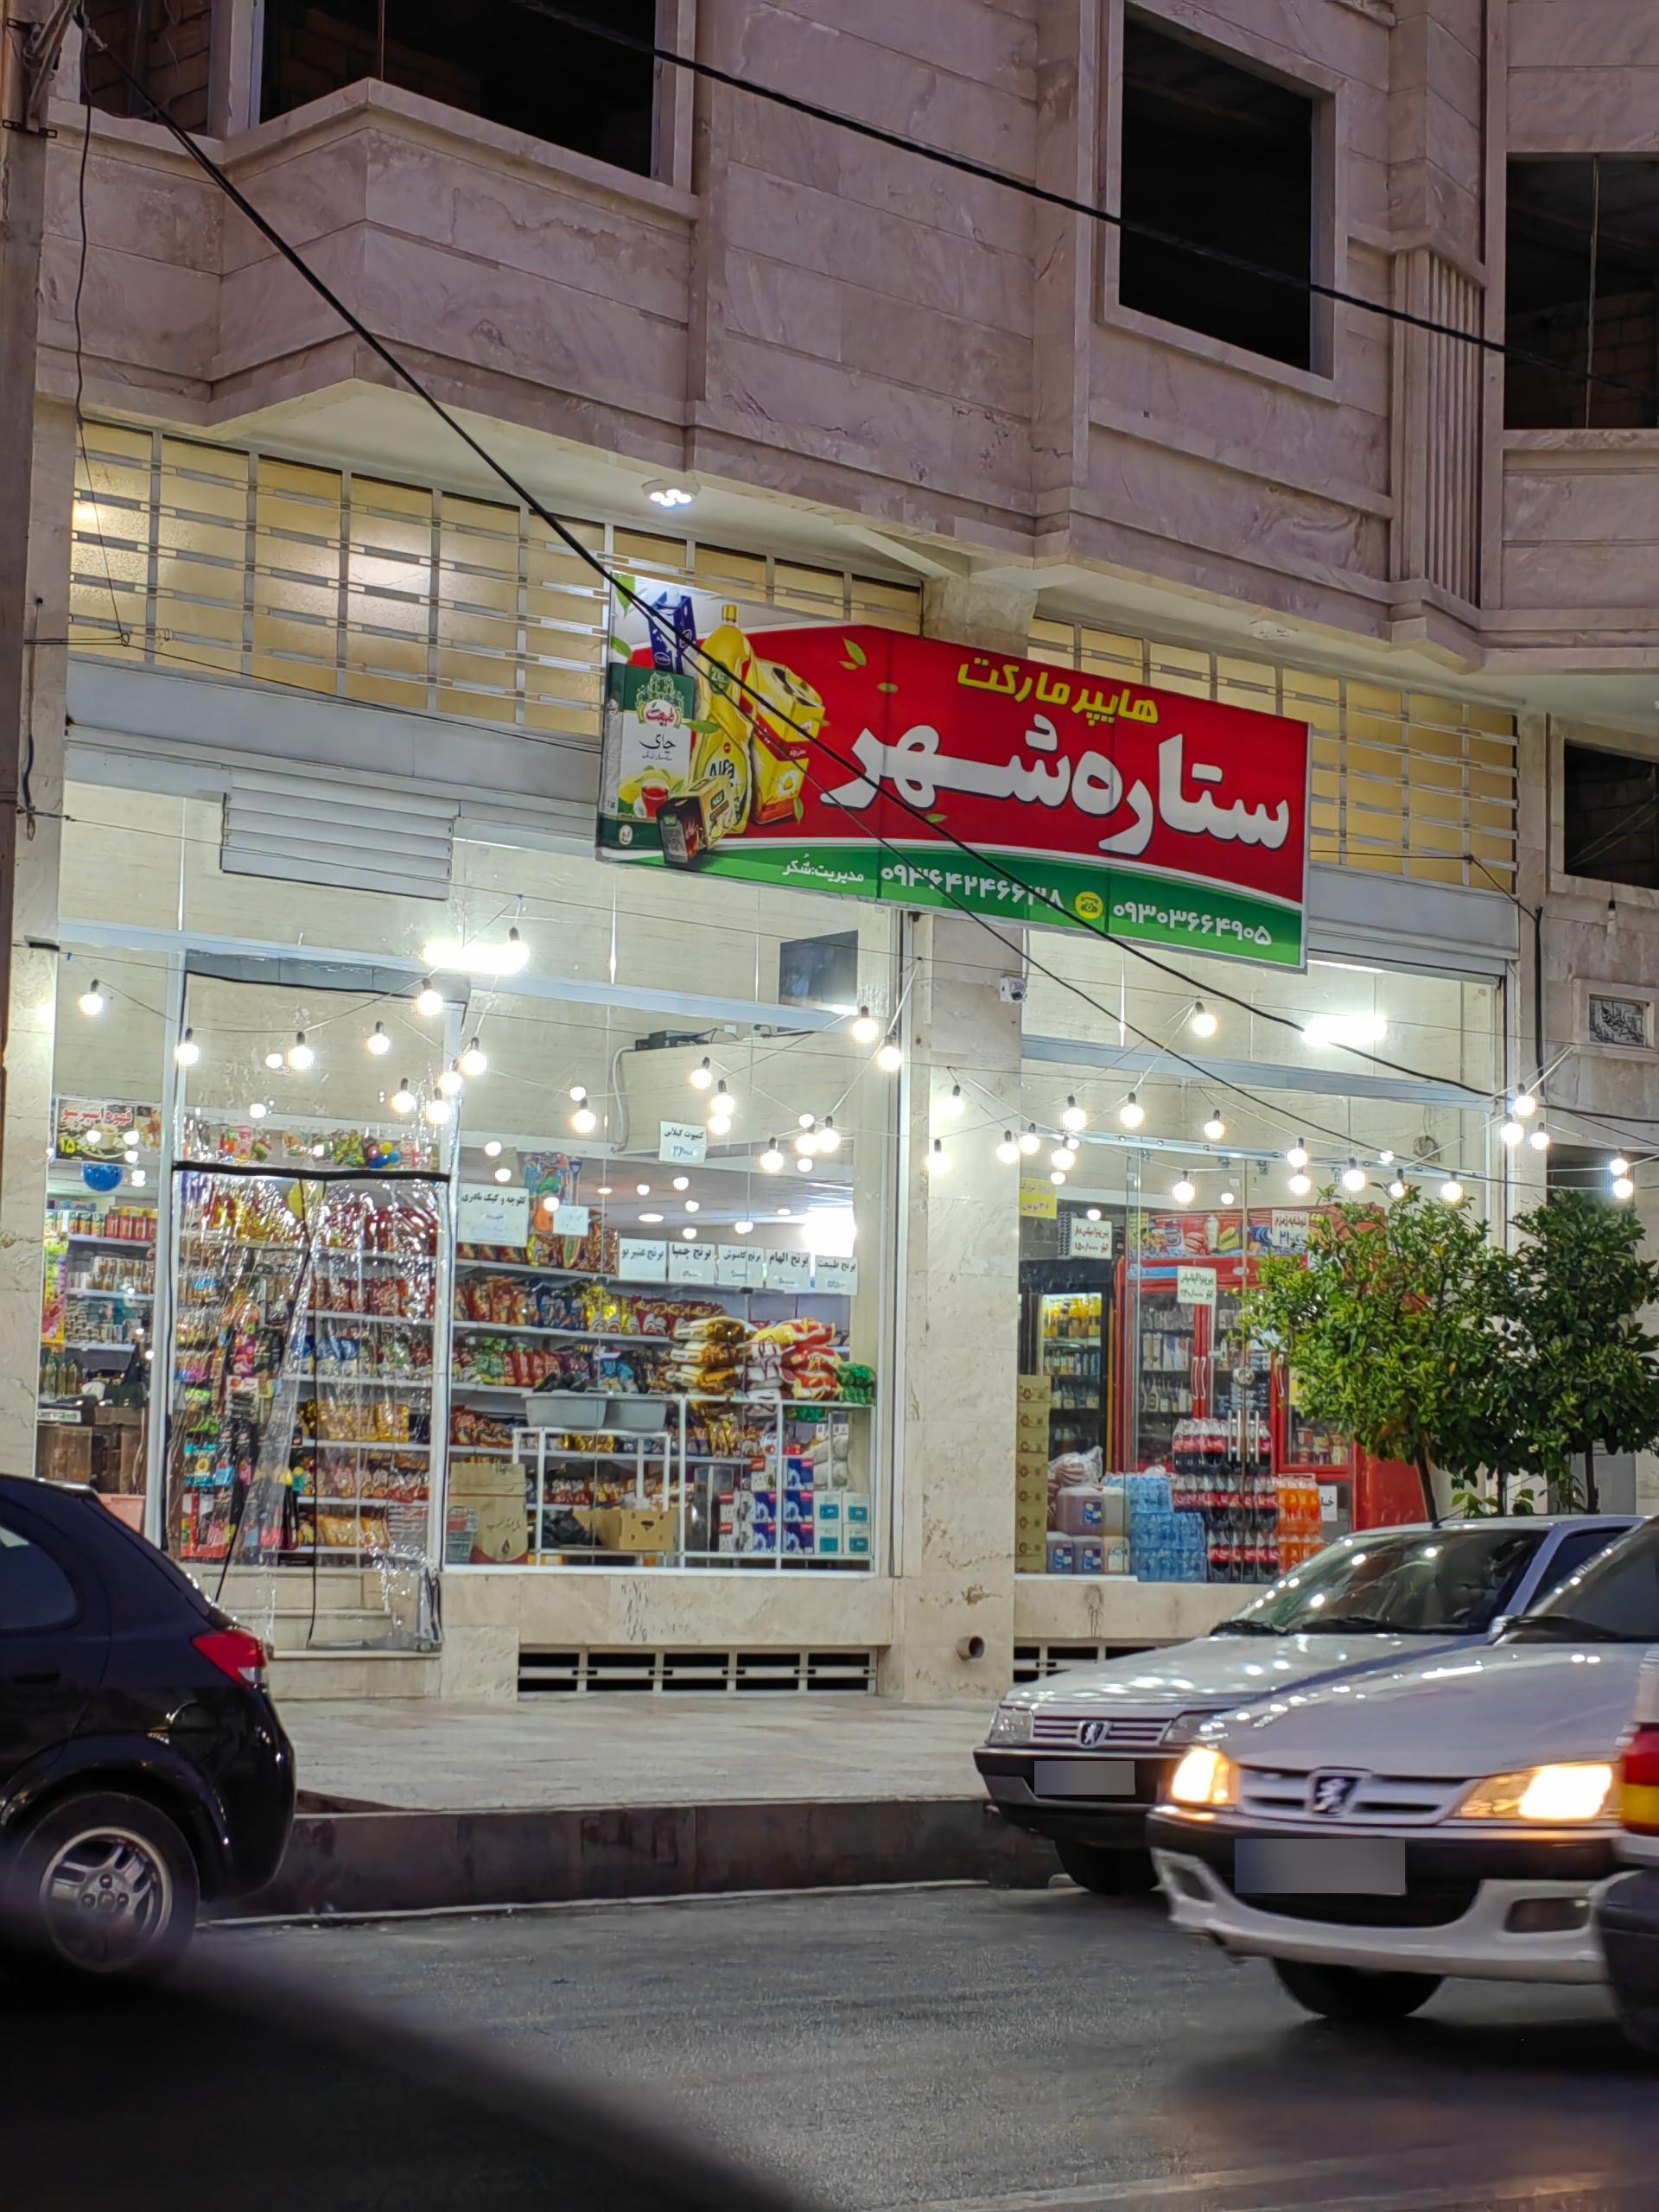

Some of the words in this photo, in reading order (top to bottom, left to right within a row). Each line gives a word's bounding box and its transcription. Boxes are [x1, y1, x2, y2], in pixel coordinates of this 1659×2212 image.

[957, 657, 1071, 706] مارکت
[1071, 687, 1160, 726] هایپر
[819, 713, 1070, 810] شهر
[1071, 733, 1291, 855] ستاره
[1113, 901, 1273, 946] ۰۹۳۰۳۶۶۴۹۰۵
